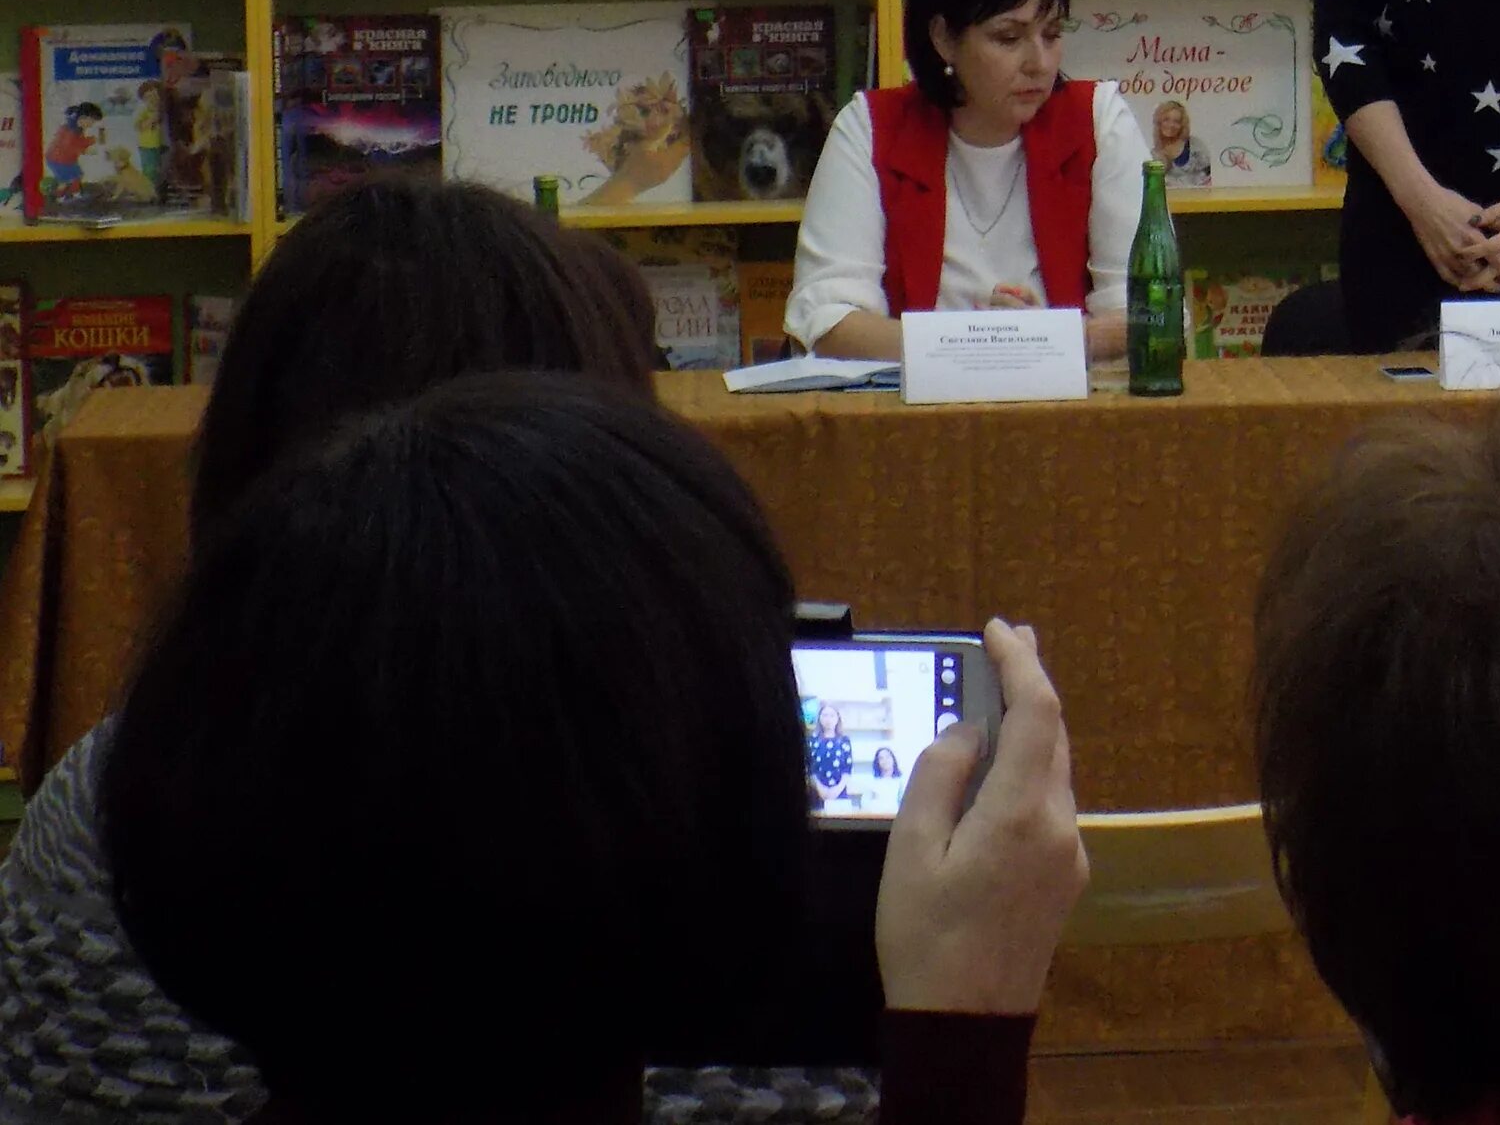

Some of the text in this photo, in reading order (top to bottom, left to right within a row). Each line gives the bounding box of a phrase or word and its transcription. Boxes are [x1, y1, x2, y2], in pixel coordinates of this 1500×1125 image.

[1127, 35, 1210, 63] Мама
[489, 61, 623, 89] Заповедного
[1118, 70, 1253, 101] ово дорогое
[490, 102, 599, 125] НЕ ТРОНЬ
[54, 327, 150, 349] КОШКИ
